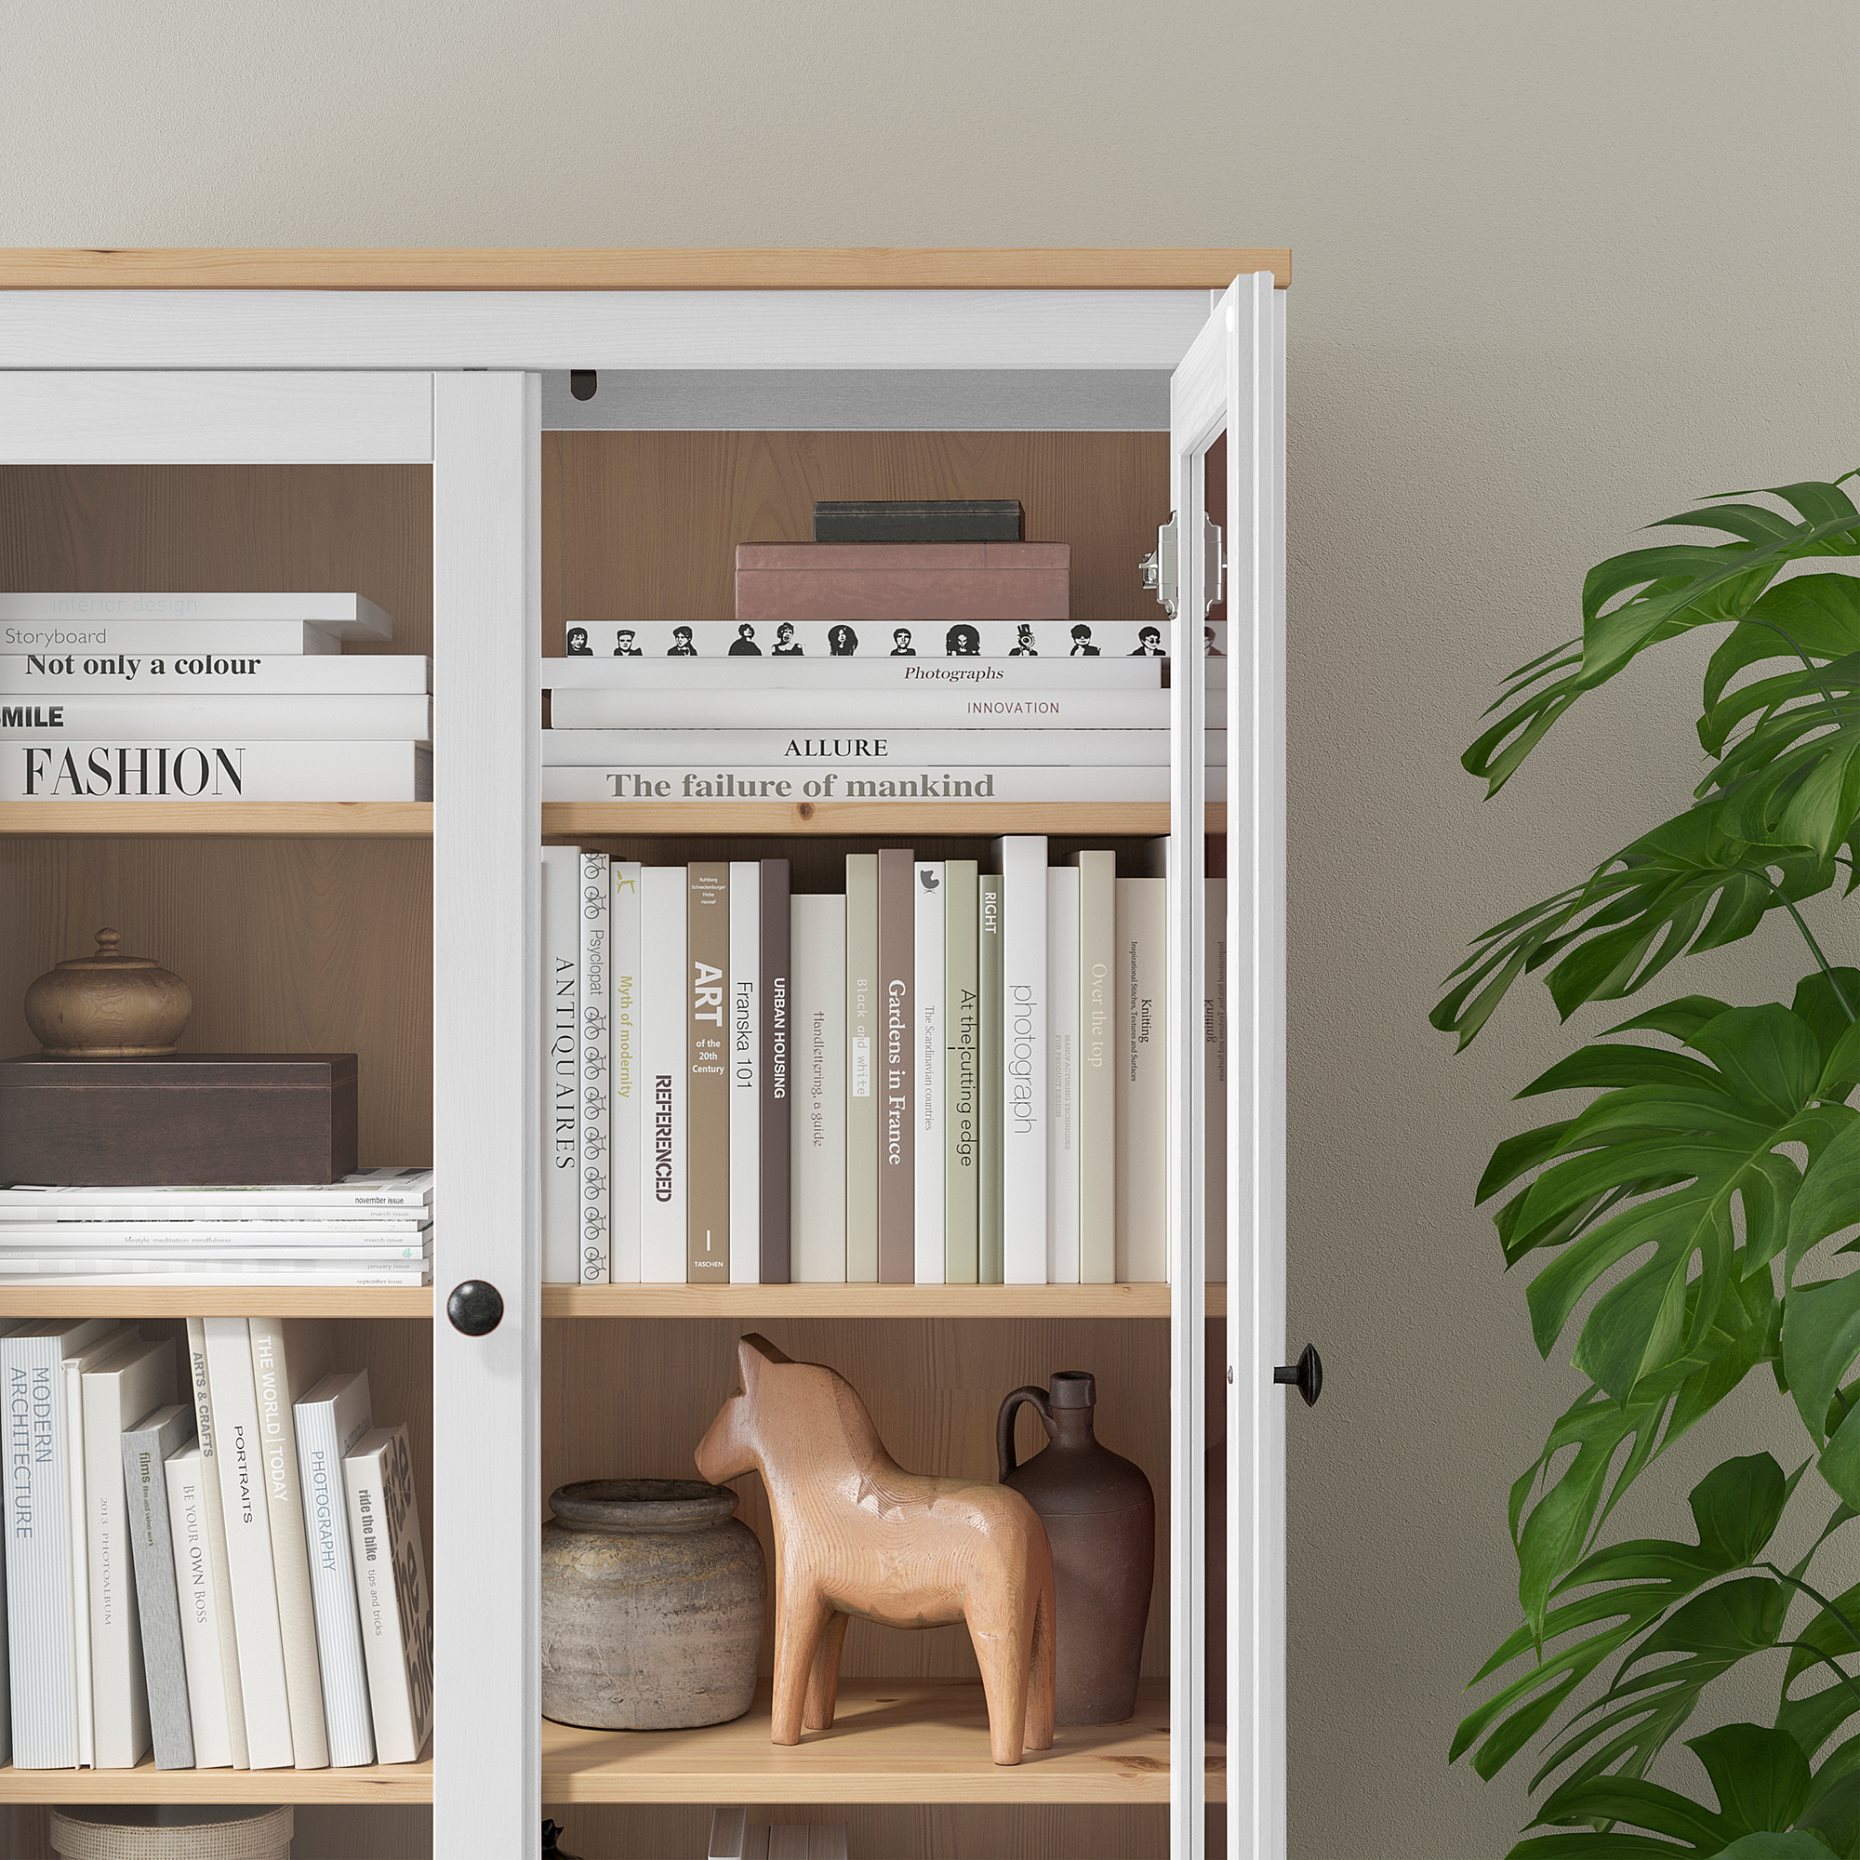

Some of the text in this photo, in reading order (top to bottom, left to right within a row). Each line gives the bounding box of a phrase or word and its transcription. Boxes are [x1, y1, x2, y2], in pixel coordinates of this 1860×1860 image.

[5, 628, 107, 648] Storyboard
[133, 596, 199, 616] design
[25, 654, 262, 681] Not only a colour
[904, 666, 1004, 683] Photographs
[967, 702, 1060, 714] INNOVATION
[0, 706, 64, 727] MILE
[784, 739, 888, 757] ALLURE
[22, 746, 246, 796] FASHION
[606, 773, 995, 797] The failure of mankind
[985, 892, 997, 934] RIGHT
[587, 930, 604, 995] Psyclopat
[695, 961, 722, 1027] ART
[1129, 941, 1138, 982] Inspirational
[618, 976, 633, 1098] Myth of modernity
[696, 1039, 720, 1047] of the
[736, 982, 753, 1088] Franska 101
[773, 978, 786, 1099] URBAN HOUSING
[856, 979, 868, 1095] Black and white
[1087, 963, 1108, 1068] Over the top
[1130, 1011, 1138, 1039] Textures
[1130, 1040, 1138, 1053] and
[1138, 999, 1152, 1043] Knitting
[551, 957, 575, 1169] ANTIQUAIRES
[692, 1064, 724, 1075] Century
[699, 1052, 718, 1061] 20th
[811, 1011, 825, 1147] Handlettering, a guide
[888, 979, 906, 1165] Gardens in France
[925, 1006, 935, 1131] The Scandinavian countries
[956, 989, 977, 1167] At the cutting edge
[1009, 985, 1037, 1134] photograph
[1130, 1054, 1138, 1081] Surfaces
[655, 1074, 672, 1203] REFERENCED
[32, 1367, 52, 1463] MODERN
[193, 1352, 213, 1457] ARTS & CRAFTS
[259, 1335, 287, 1501] THE WORLD TODAY
[11, 1367, 32, 1539] ARCHITECTURE
[139, 1451, 151, 1483] films
[234, 1425, 252, 1524] PORTRAITS
[311, 1451, 336, 1571] PHOTOGRAPHY
[100, 1497, 112, 1625] 2013 PHOTOALBUM
[183, 1485, 207, 1624] BE YOUR OWN BOSS
[358, 1489, 382, 1637] ride the bike tips and tricks
